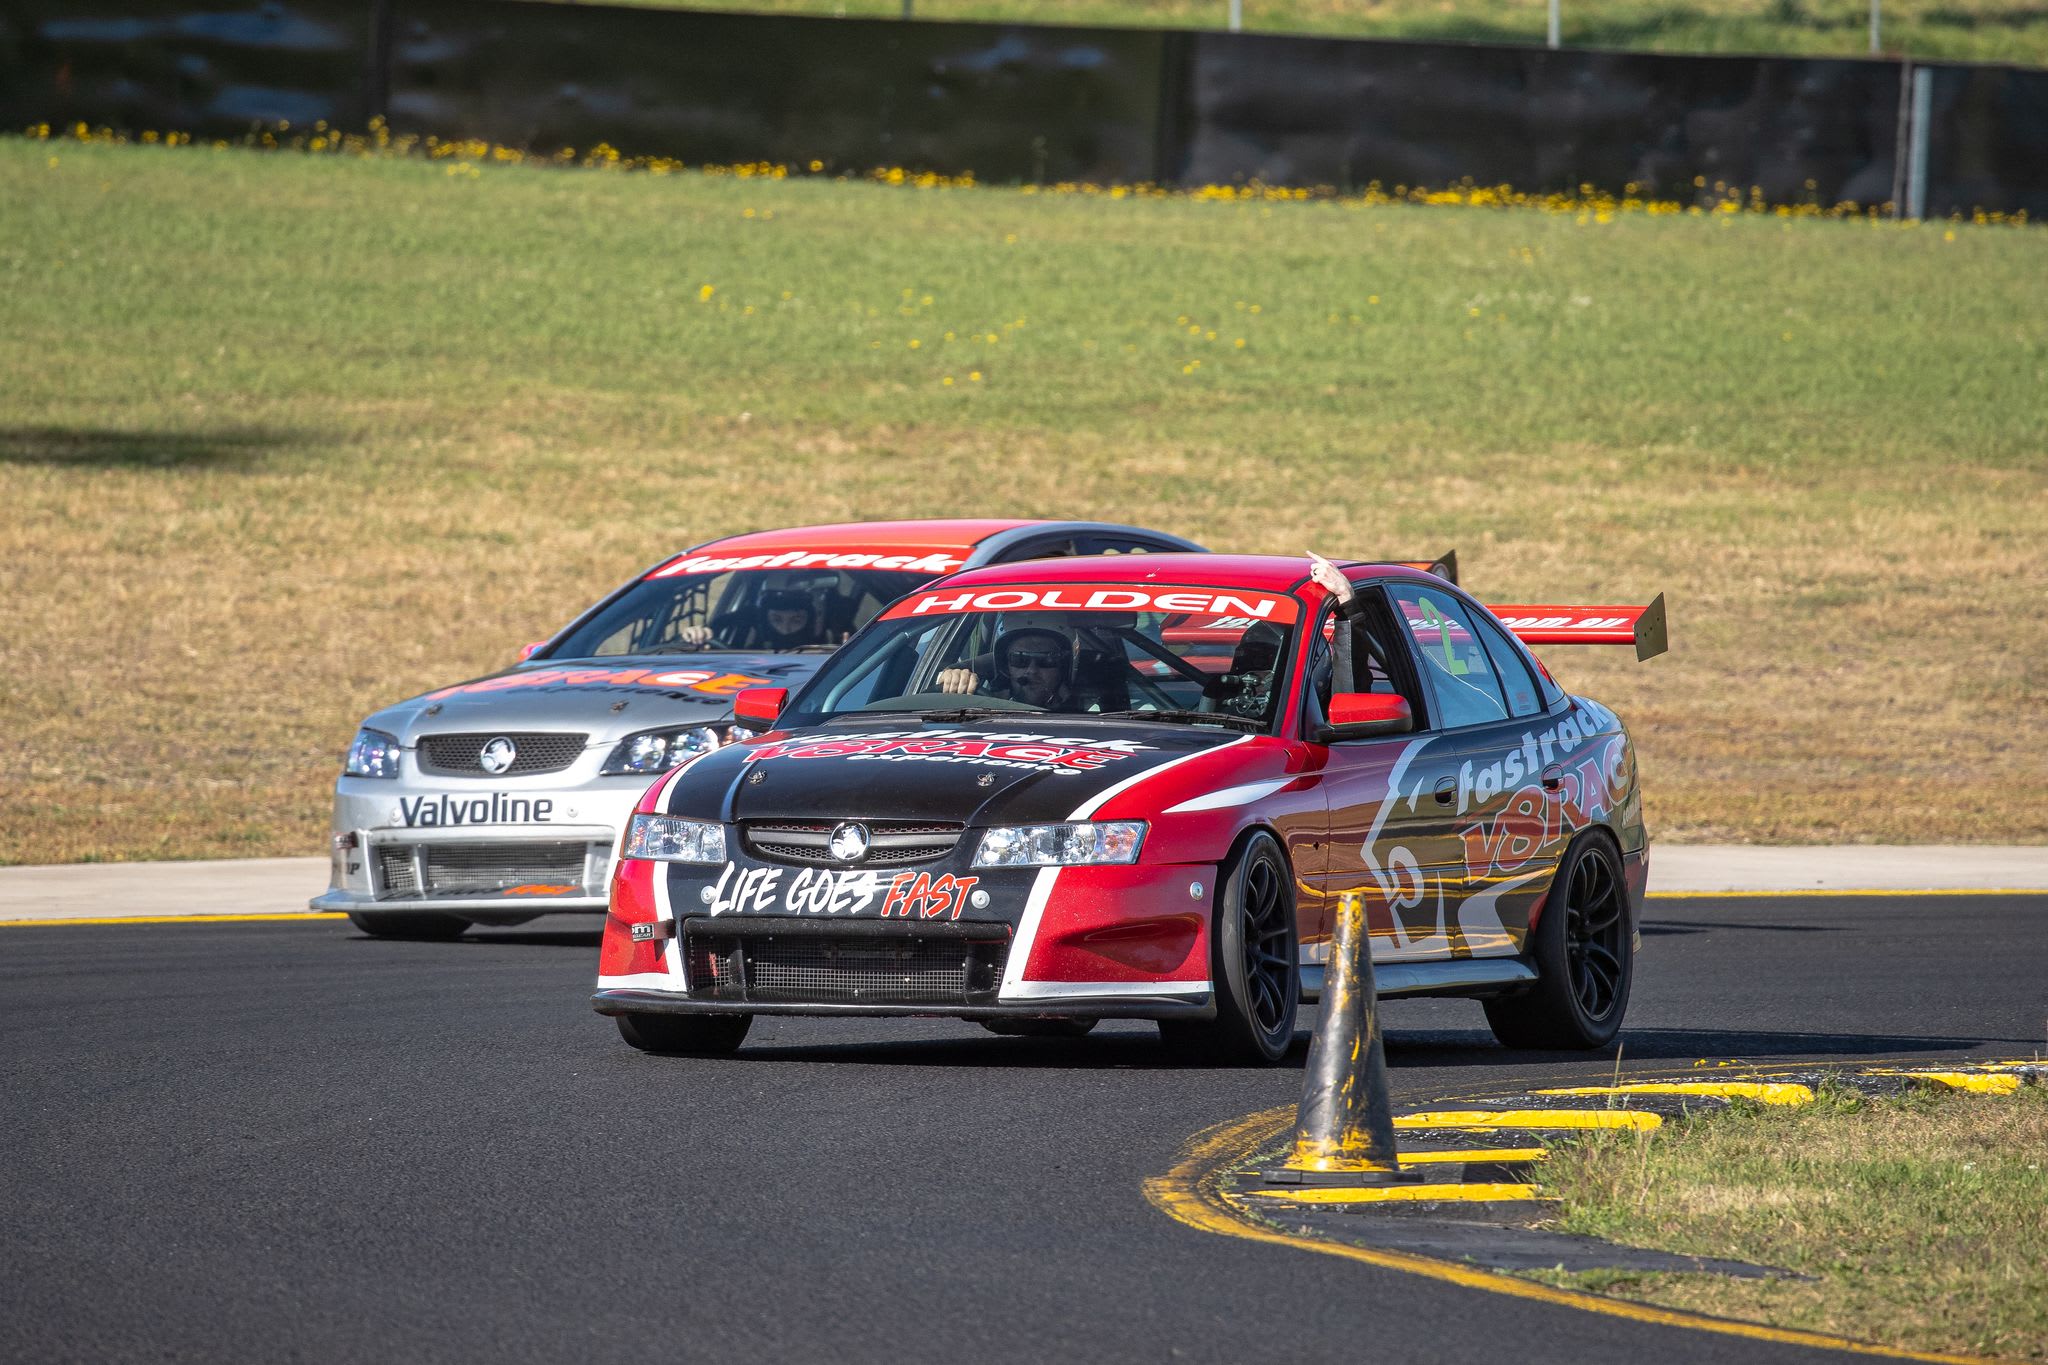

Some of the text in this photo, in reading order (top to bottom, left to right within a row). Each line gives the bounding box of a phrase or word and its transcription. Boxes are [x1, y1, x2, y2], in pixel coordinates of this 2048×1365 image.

[655, 551, 965, 577] fastrack
[912, 590, 1276, 617] HOLDEN
[742, 739, 1130, 770] V8RACE
[1456, 698, 1609, 817] fastrack
[399, 792, 554, 827] Valvoline
[710, 861, 980, 921] LIFE GOES FAST
